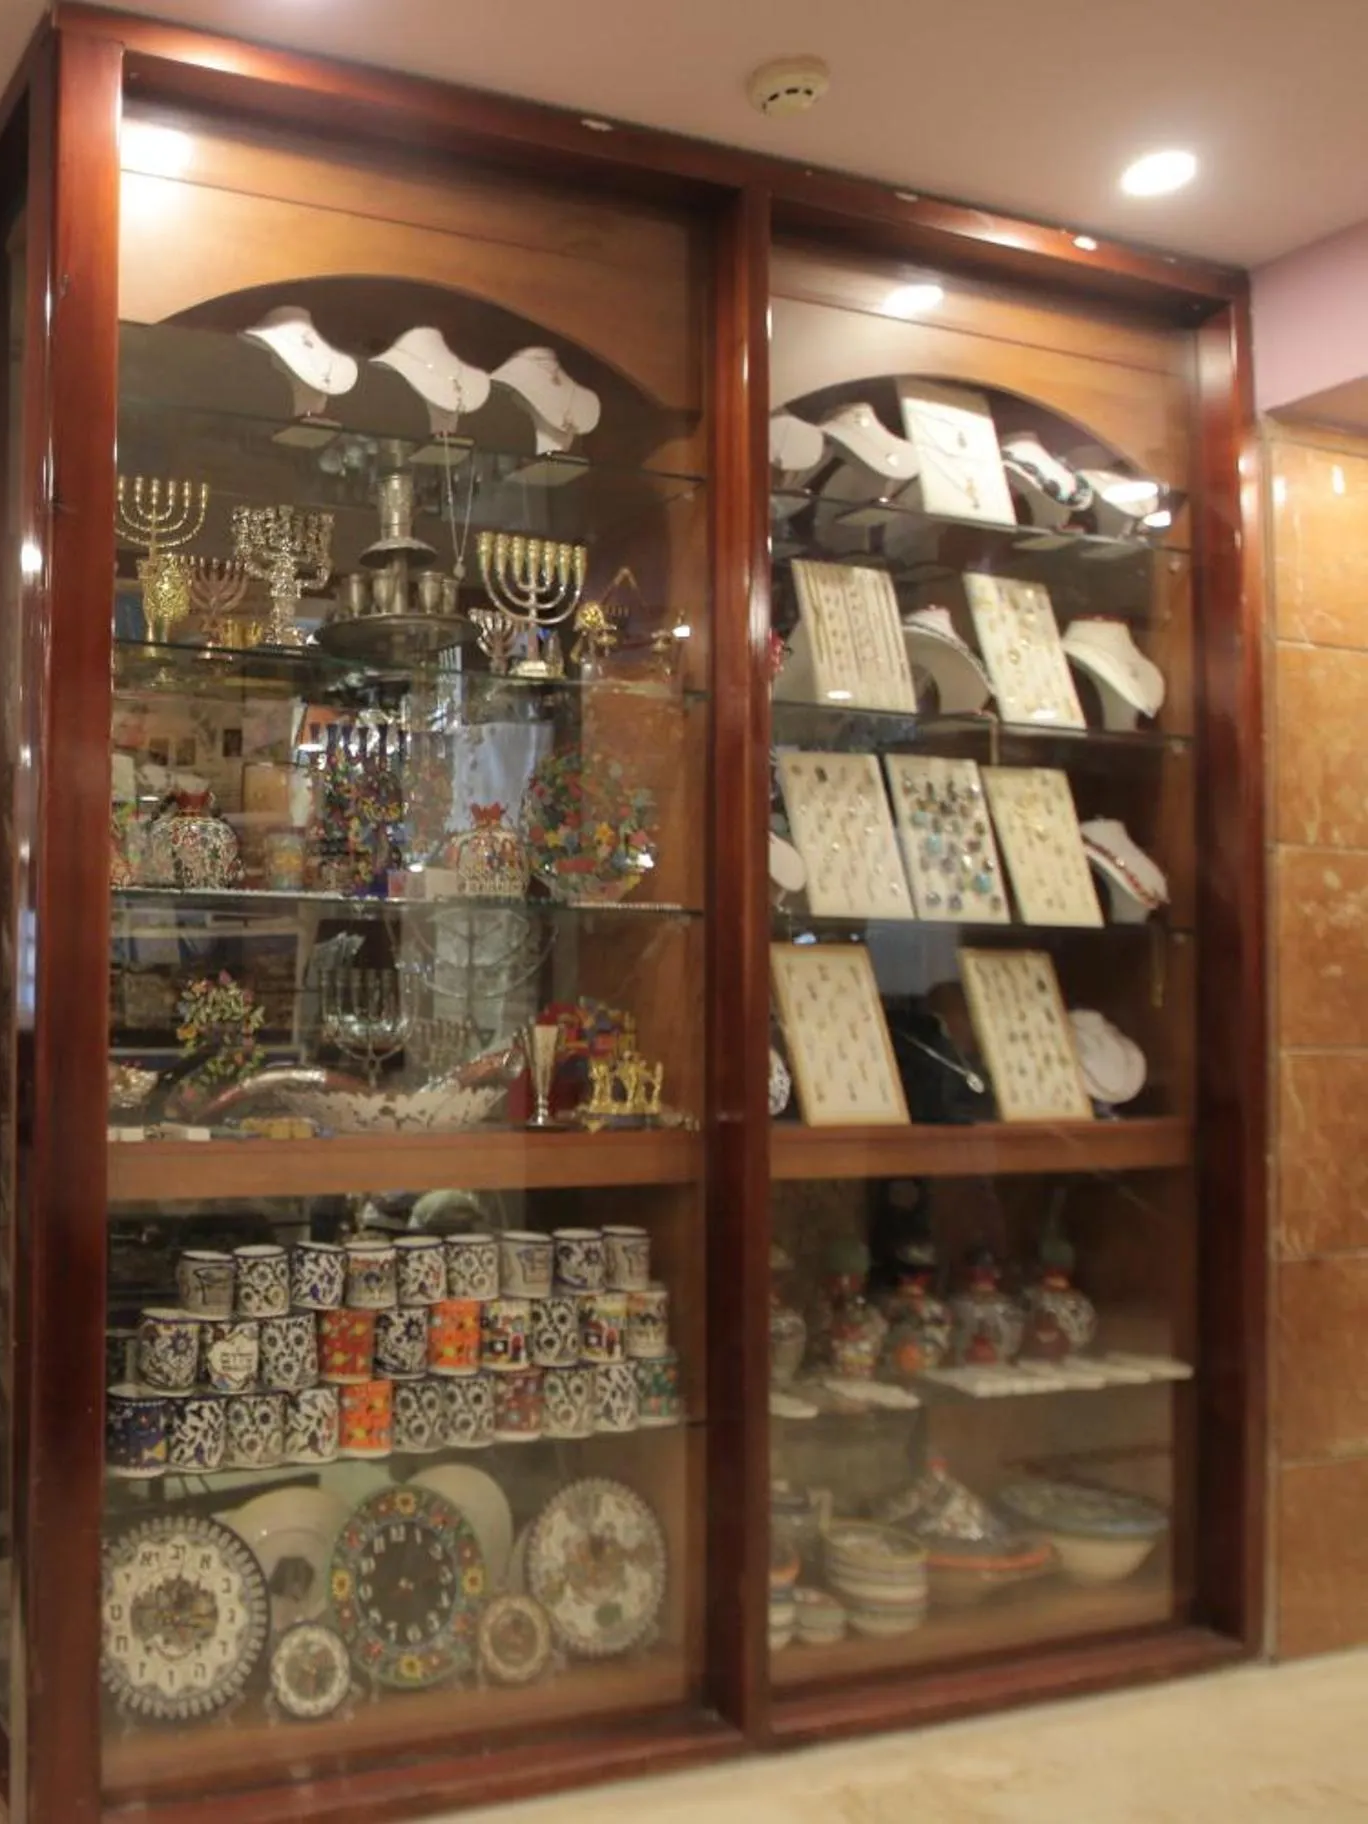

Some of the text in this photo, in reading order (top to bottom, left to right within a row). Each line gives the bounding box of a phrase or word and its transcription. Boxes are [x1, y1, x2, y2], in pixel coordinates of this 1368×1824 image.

[200, 1553, 212, 1570] א
[221, 1578, 231, 1594] ב
[109, 1604, 123, 1621] ט
